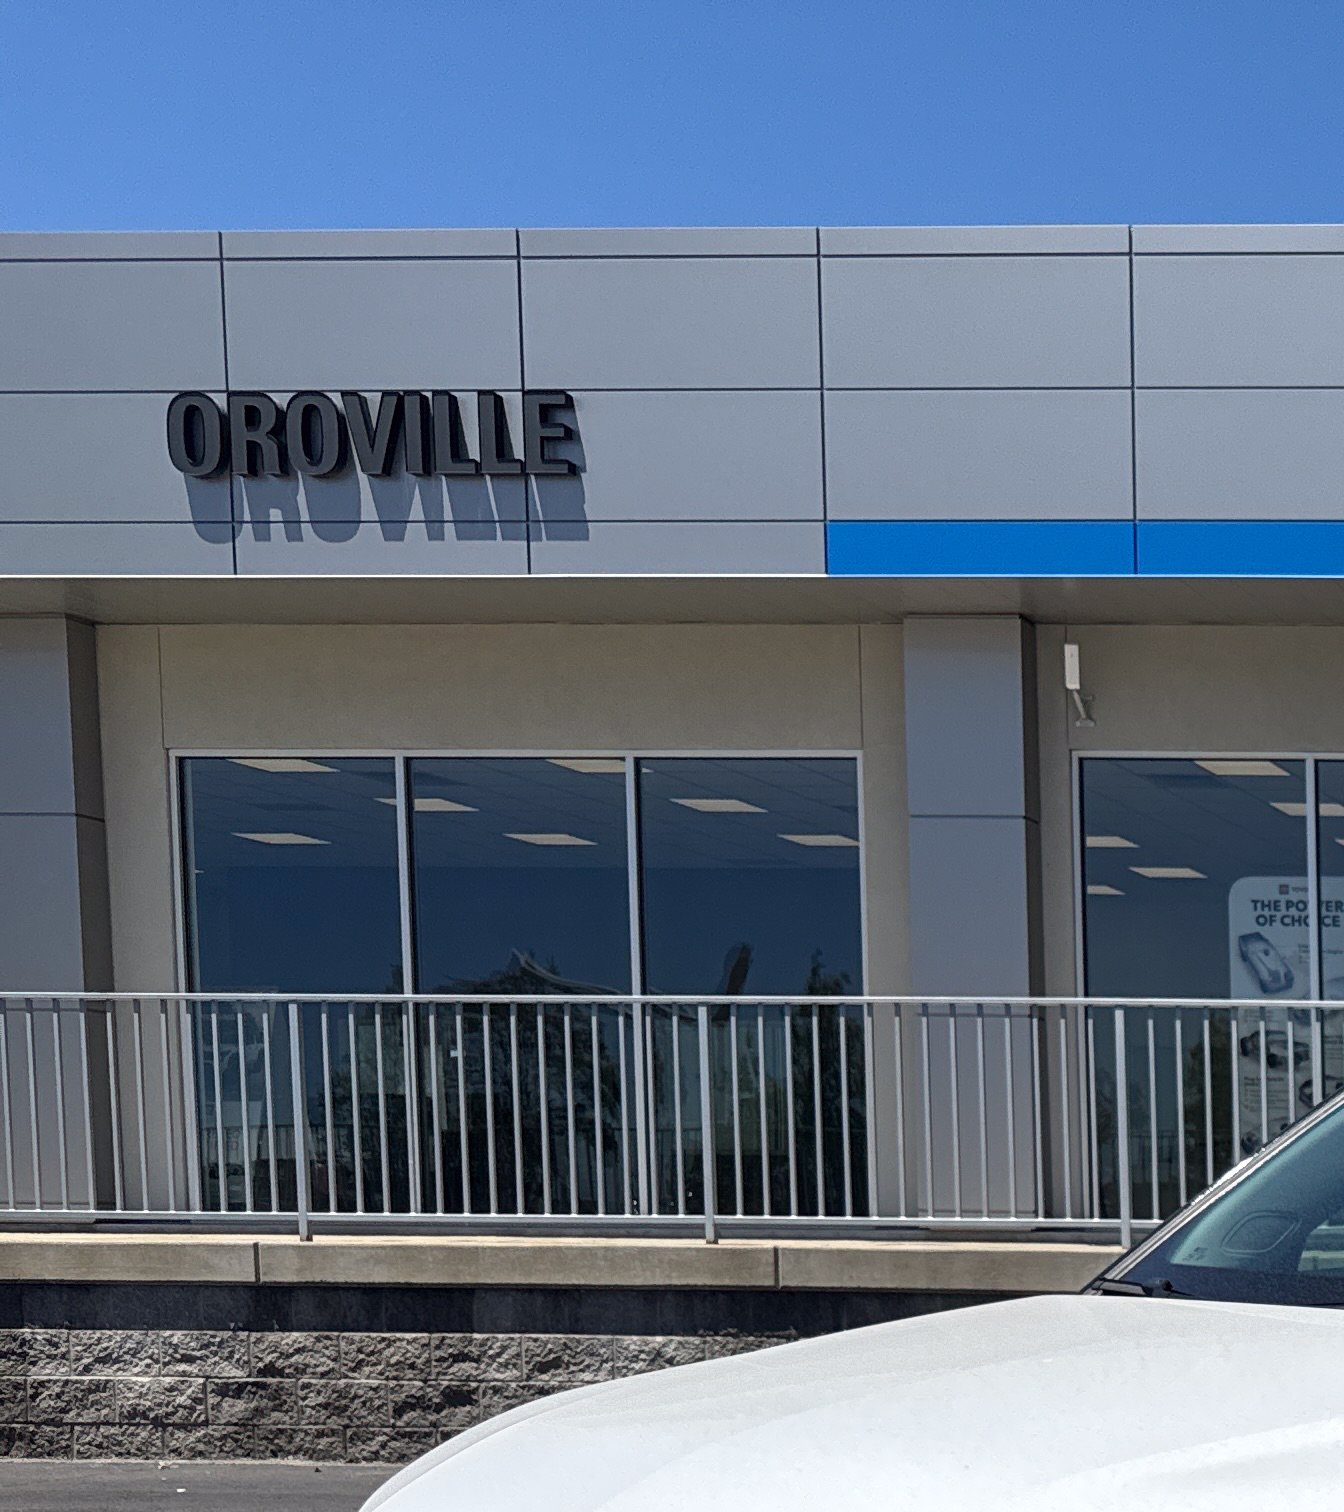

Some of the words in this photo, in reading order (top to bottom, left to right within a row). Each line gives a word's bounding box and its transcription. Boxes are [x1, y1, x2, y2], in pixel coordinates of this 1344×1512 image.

[166, 389, 575, 478] OROVILLE
[1250, 900, 1281, 912] THE
[1286, 900, 1344, 912] POER
[1255, 915, 1277, 927] OF
[1280, 915, 1341, 927] CHCE
